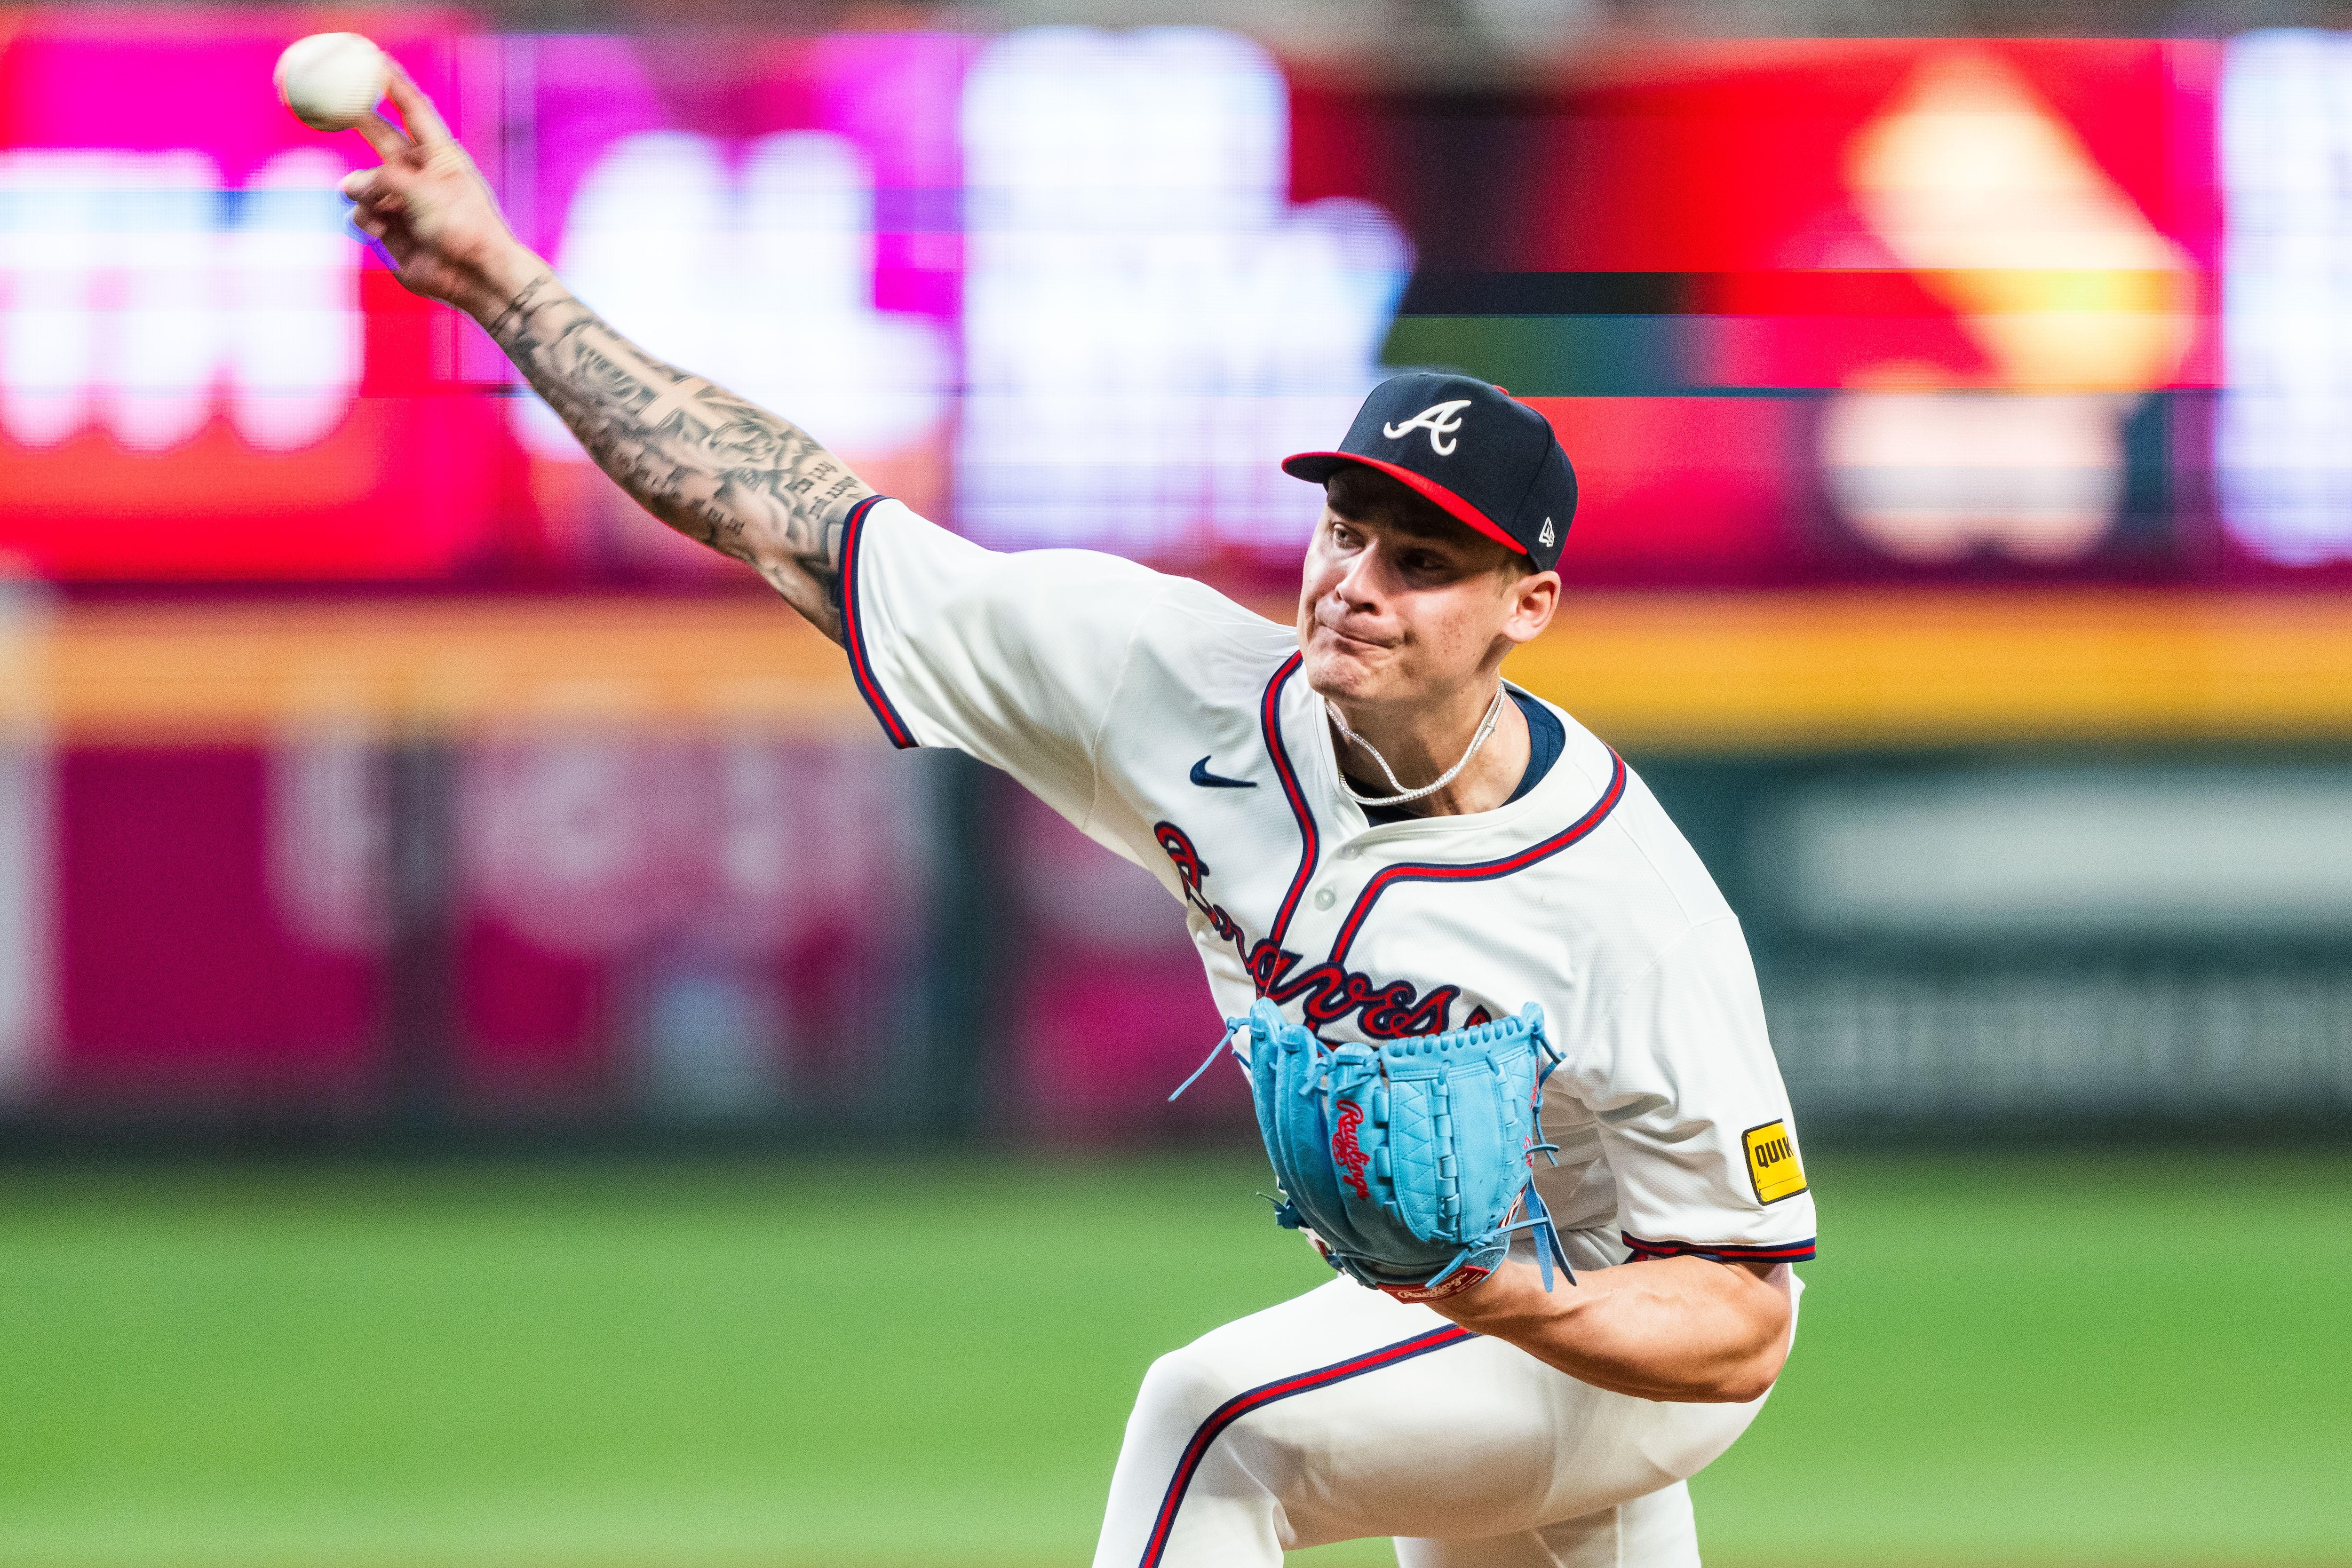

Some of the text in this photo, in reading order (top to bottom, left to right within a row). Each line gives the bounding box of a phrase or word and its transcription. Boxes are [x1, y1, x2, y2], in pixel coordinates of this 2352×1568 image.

[1383, 399, 1472, 456] A
[1332, 1099, 1371, 1200] Rawlings
[1397, 1272, 1468, 1299] Rawlings
